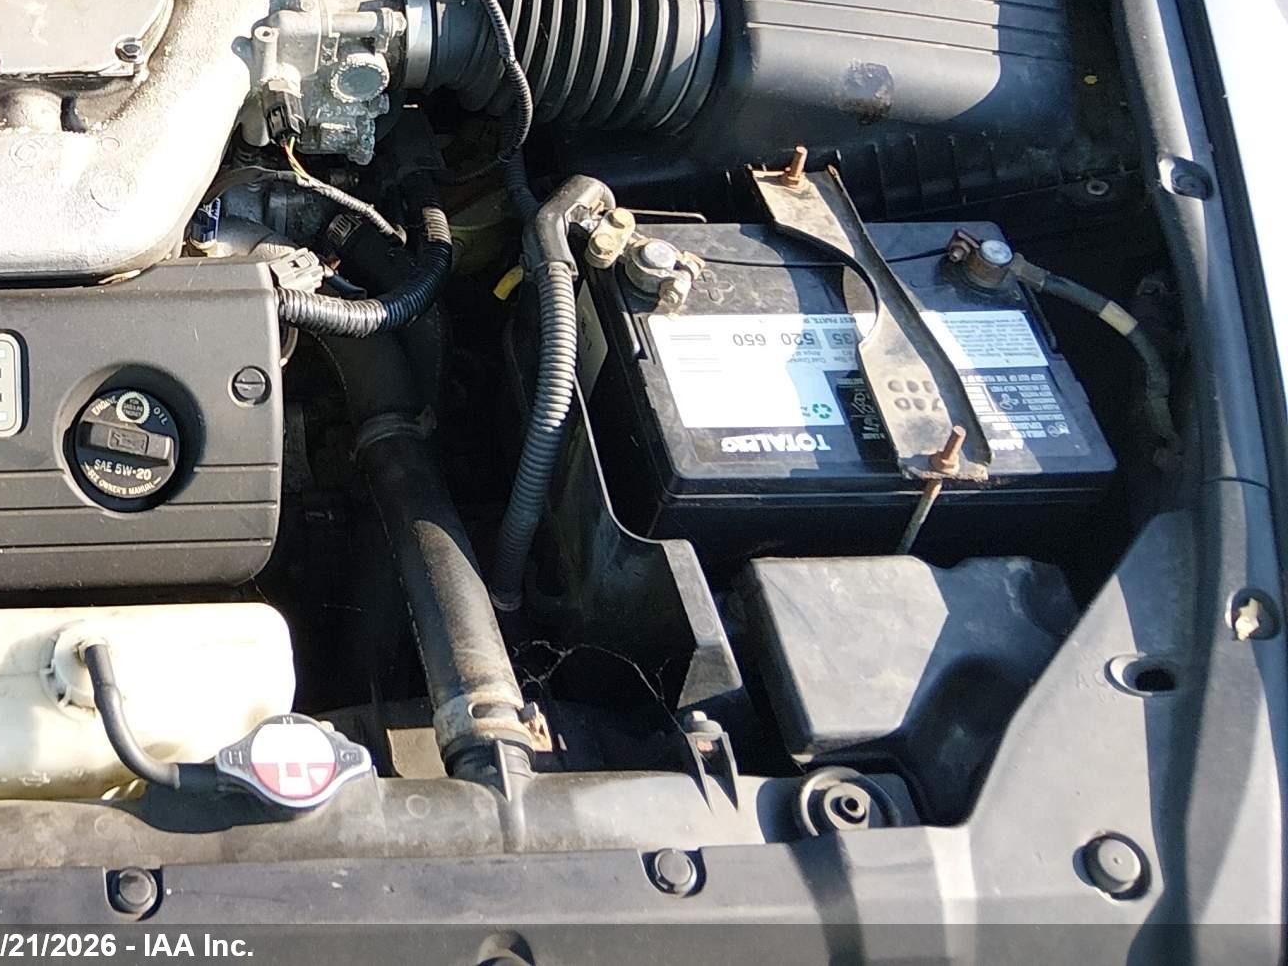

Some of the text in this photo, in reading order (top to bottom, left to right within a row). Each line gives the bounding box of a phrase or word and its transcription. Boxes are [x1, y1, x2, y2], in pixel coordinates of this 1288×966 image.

[732, 333, 767, 347] 650
[780, 332, 816, 347] 520
[153, 407, 169, 425] OIL
[94, 458, 152, 480] SAE 5W-20
[127, 481, 155, 495] MANUAL
